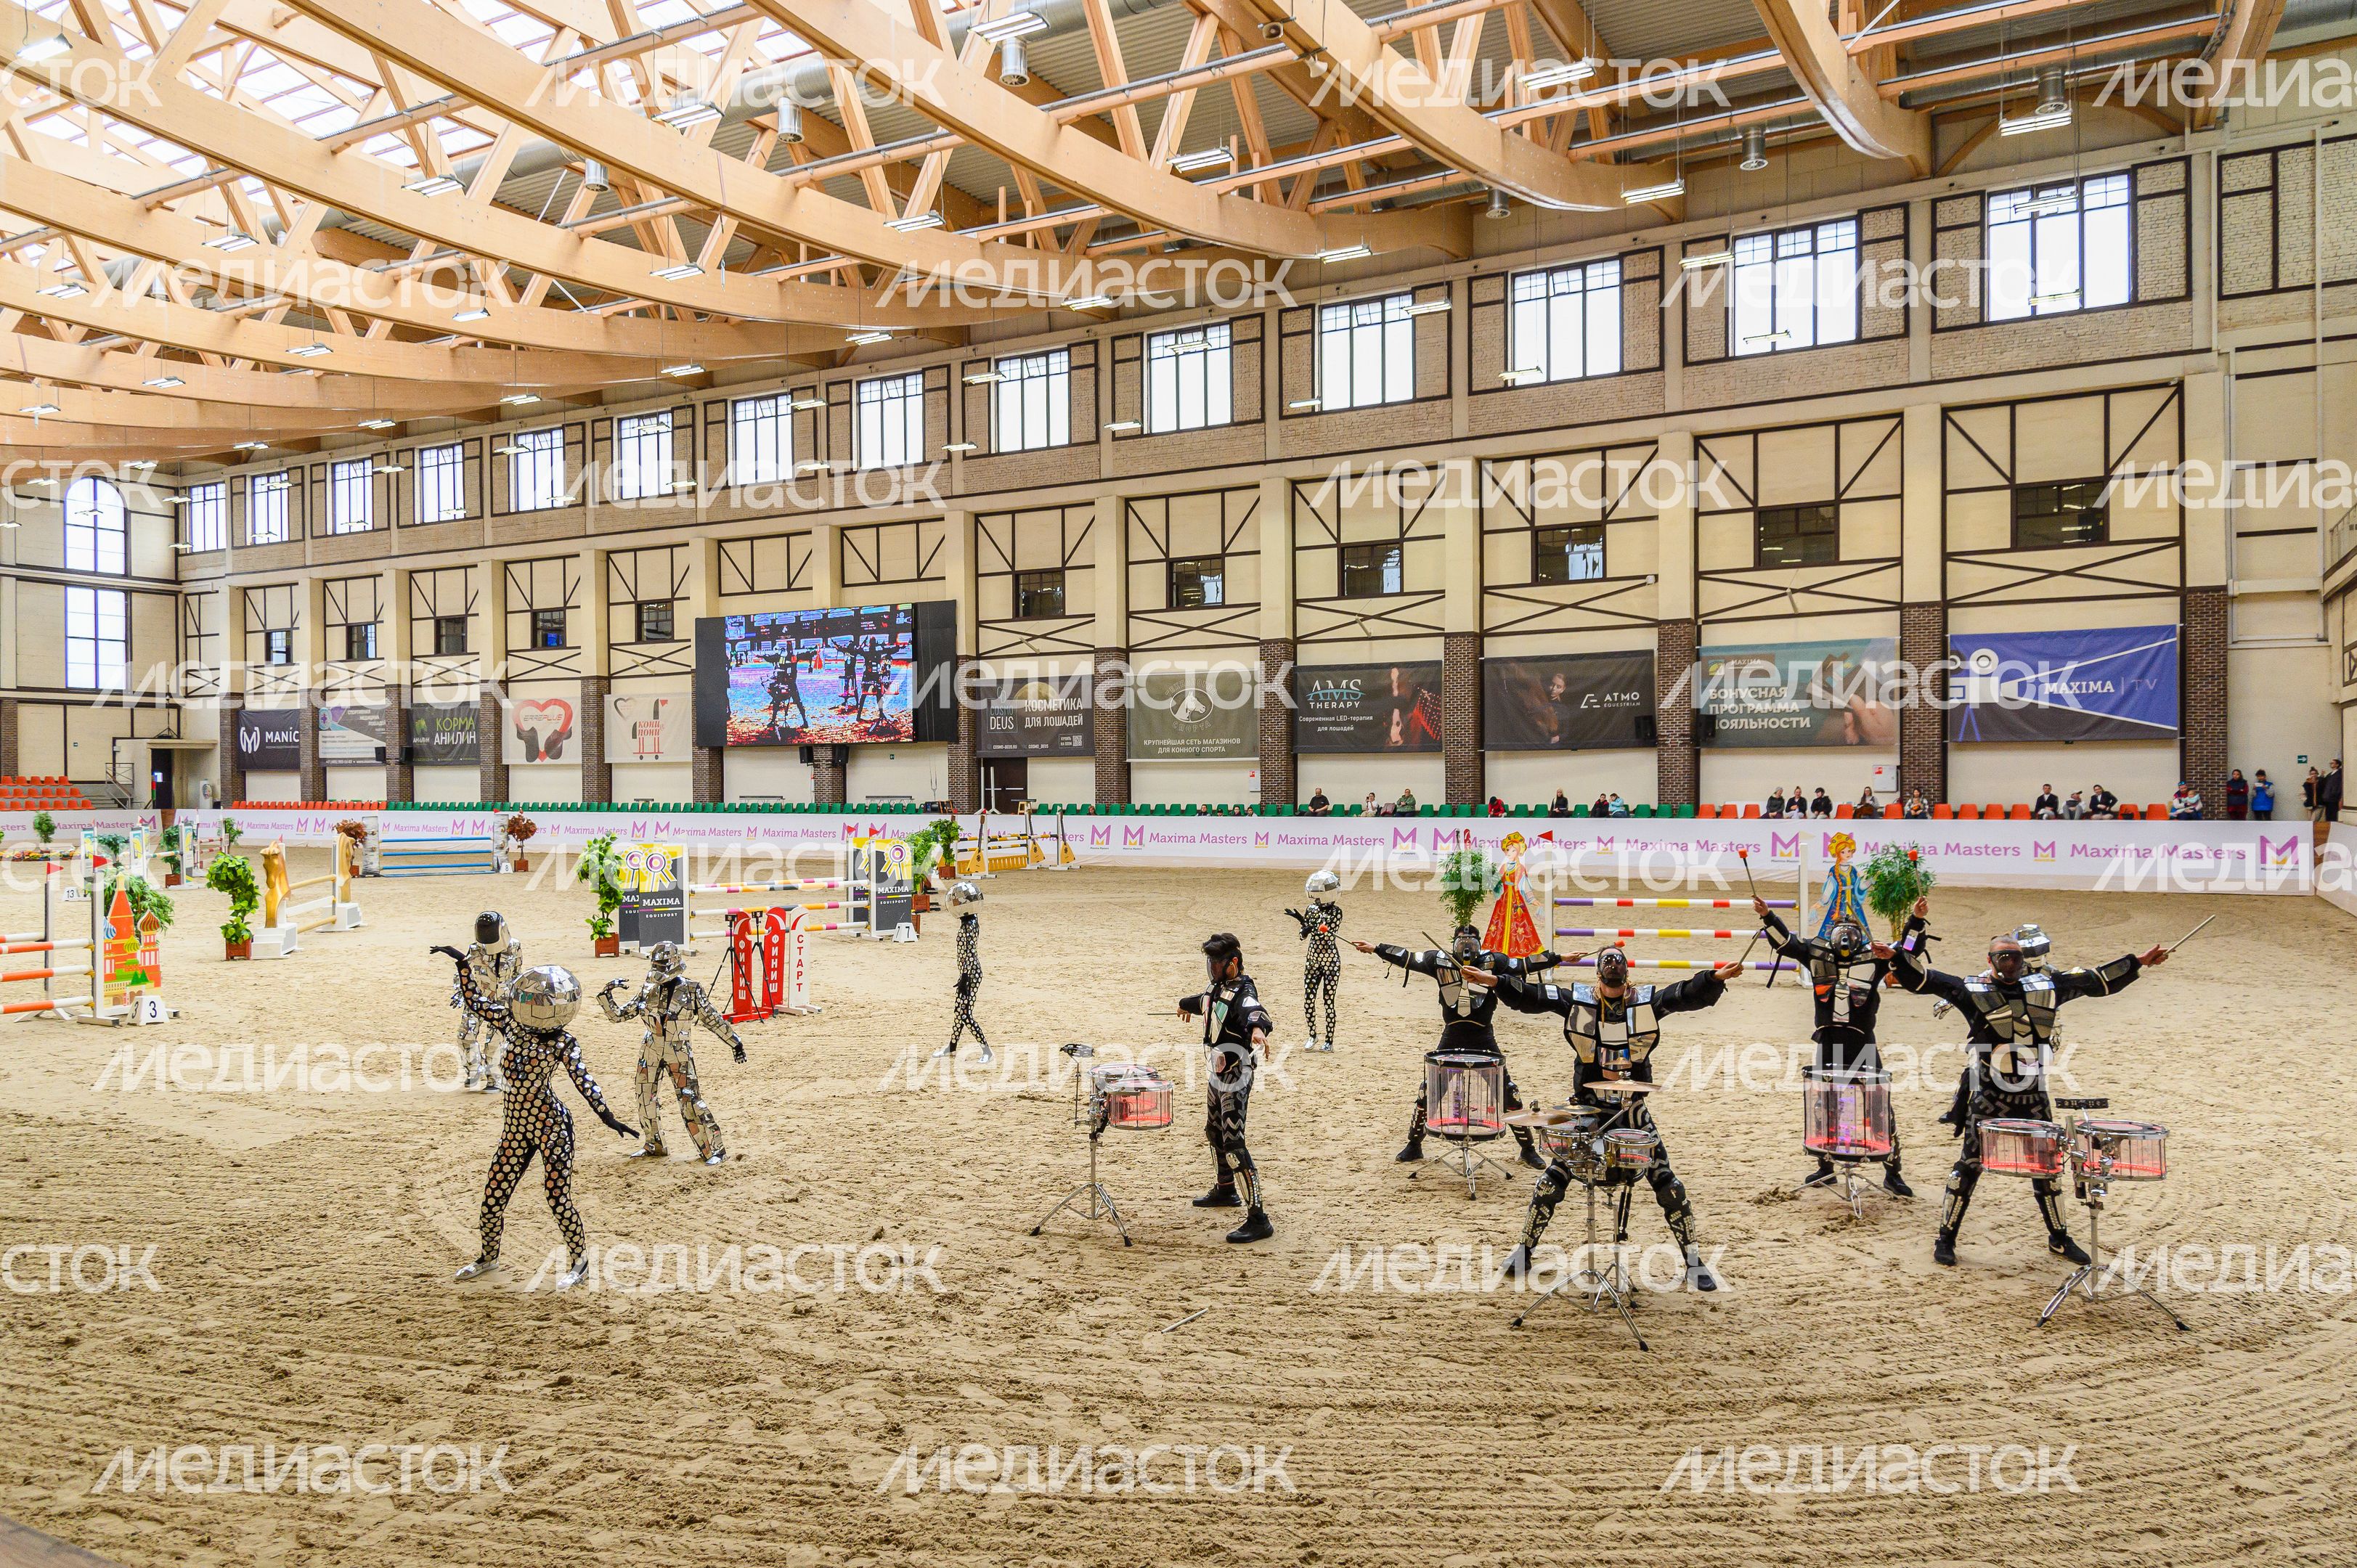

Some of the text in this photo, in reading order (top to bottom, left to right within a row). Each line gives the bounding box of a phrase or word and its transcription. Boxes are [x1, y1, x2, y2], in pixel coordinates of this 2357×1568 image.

[1308, 679, 1362, 701] AMS
[1709, 687, 1788, 700] БОНУСНАЯ
[2044, 680, 2115, 695] MAXIMA
[1604, 691, 1640, 702] ATMO
[990, 705, 1014, 716] COSMO
[1025, 698, 1083, 712] КОСМЕТИКА
[1709, 701, 1800, 715] ПРОГРАММА
[436, 716, 475, 732] КОРМА
[990, 716, 1014, 730] DEUS
[1025, 714, 1083, 728] ДЛЯ ЛОШАДЕЙ
[434, 732, 476, 746] АНИЛИН
[96, 820, 135, 830] Masters
[271, 822, 294, 830] Masters
[393, 824, 419, 833] Maxima
[420, 824, 449, 833] Masters
[563, 825, 595, 835] Maxima
[596, 825, 627, 836] Masters
[672, 827, 707, 837] Maxima
[709, 827, 742, 837] Masters
[762, 828, 798, 838] Maxima
[800, 828, 836, 838] Masters
[1149, 833, 1196, 844] Maxima
[1199, 833, 1247, 844] Masters
[1277, 834, 1329, 846] Maxima
[1332, 834, 1385, 847] Masters
[1528, 837, 1587, 850] Masters
[1625, 838, 1690, 853] Maxima
[1695, 840, 1761, 854] Masters
[1944, 843, 2022, 857] Masters
[2070, 844, 2155, 859] Maxima
[2161, 846, 2247, 860] Masters
[66, 889, 75, 899] 13
[877, 886, 909, 894] MAXIMA
[643, 897, 681, 907] MAXIMA
[905, 926, 910, 939] 7
[769, 934, 780, 993] ФИНИШ
[149, 1000, 157, 1018] 3
